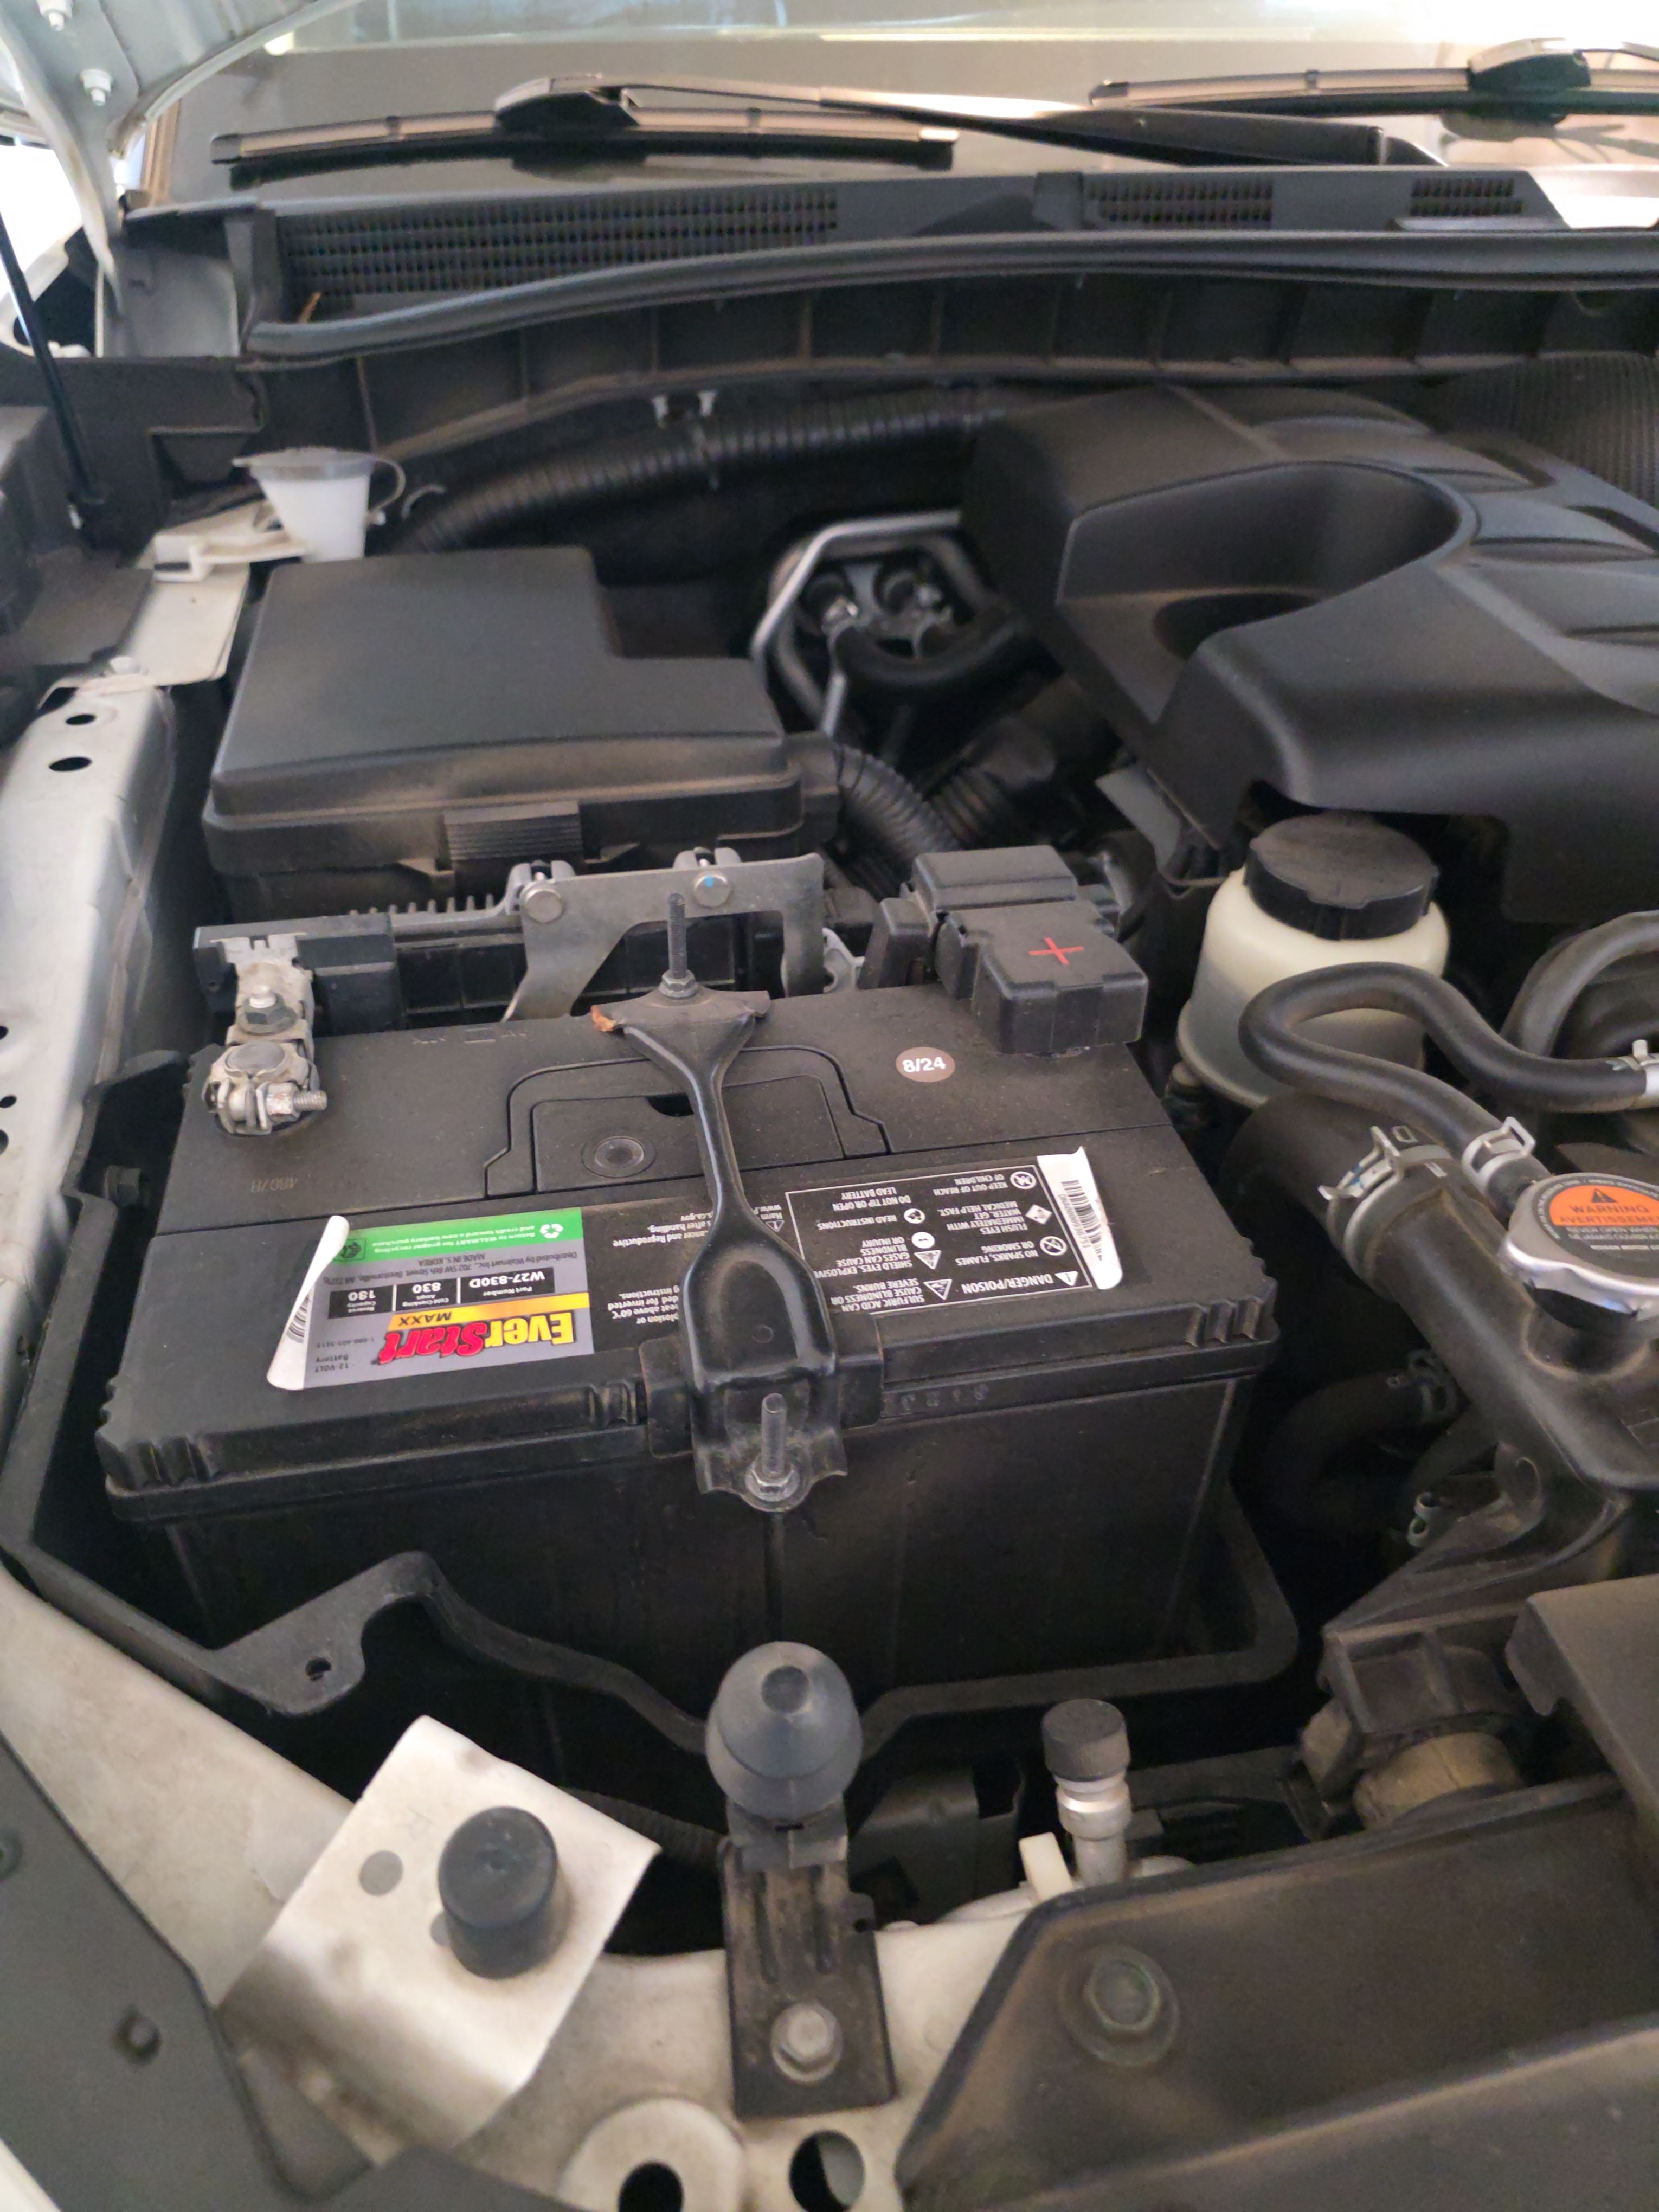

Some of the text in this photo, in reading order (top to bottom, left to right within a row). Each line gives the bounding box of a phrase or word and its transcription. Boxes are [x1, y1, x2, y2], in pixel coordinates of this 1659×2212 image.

[902, 1057, 946, 1072] 8/24
[954, 1175, 993, 1185] CHILDREN
[841, 1187, 897, 1200] LEAD BATTERY
[933, 1187, 960, 1196] REACH
[854, 1200, 867, 1208] OR
[882, 1197, 898, 1206] NOT
[898, 1195, 911, 1204] DO
[832, 1201, 854, 1211] OPEN
[937, 1200, 1018, 1216] MEDICAL HELP FAST.
[1569, 1205, 1649, 1213] WARNING
[680, 1205, 782, 1221] www.P s.ca.gov
[761, 1212, 782, 1220] Harm
[974, 1208, 1021, 1220] WATER. GET
[687, 1221, 706, 1230] after
[816, 1214, 897, 1230] READ INSTRUCTIONS
[946, 1216, 1025, 1231] IMMEDIATELY WITH
[647, 1223, 686, 1233] handling.
[980, 1223, 1028, 1235] FLUSH EYES
[613, 1234, 665, 1248] Reproductive
[667, 1233, 682, 1243] and
[862, 1236, 905, 1248] OR INJURY
[860, 1244, 908, 1256] BLINDNESS
[981, 1240, 1035, 1253] OR SMOKING
[418, 1257, 443, 1266] KOREA
[463, 1253, 485, 1262] MADE
[491, 1258, 524, 1267] Walmart
[537, 1251, 577, 1263] Distributed
[835, 1252, 910, 1267] GASES CAN CAUSE
[955, 1250, 1039, 1266] NO SPARKS, FLAMES
[858, 1264, 882, 1272] EYES.
[882, 1259, 913, 1270] SHIELD
[470, 1271, 545, 1288] W27-830D
[961, 1274, 1054, 1294] DANGER/POISON
[412, 1282, 441, 1294] 830
[853, 1278, 919, 1293] SEVERE BURNS.
[348, 1290, 376, 1301] 180
[483, 1288, 515, 1296] Number
[619, 1288, 672, 1299] instructions.
[831, 1287, 922, 1304] CAUSE BLINDNESS OR
[608, 1300, 645, 1311] inverted
[841, 1295, 925, 1312] SULFURIC ACID CAN
[633, 1306, 660, 1314] above
[399, 1311, 452, 1326] MAXX
[647, 1313, 679, 1323] plosion
[378, 1311, 574, 1365] EverStart
[316, 1354, 348, 1362] Battery
